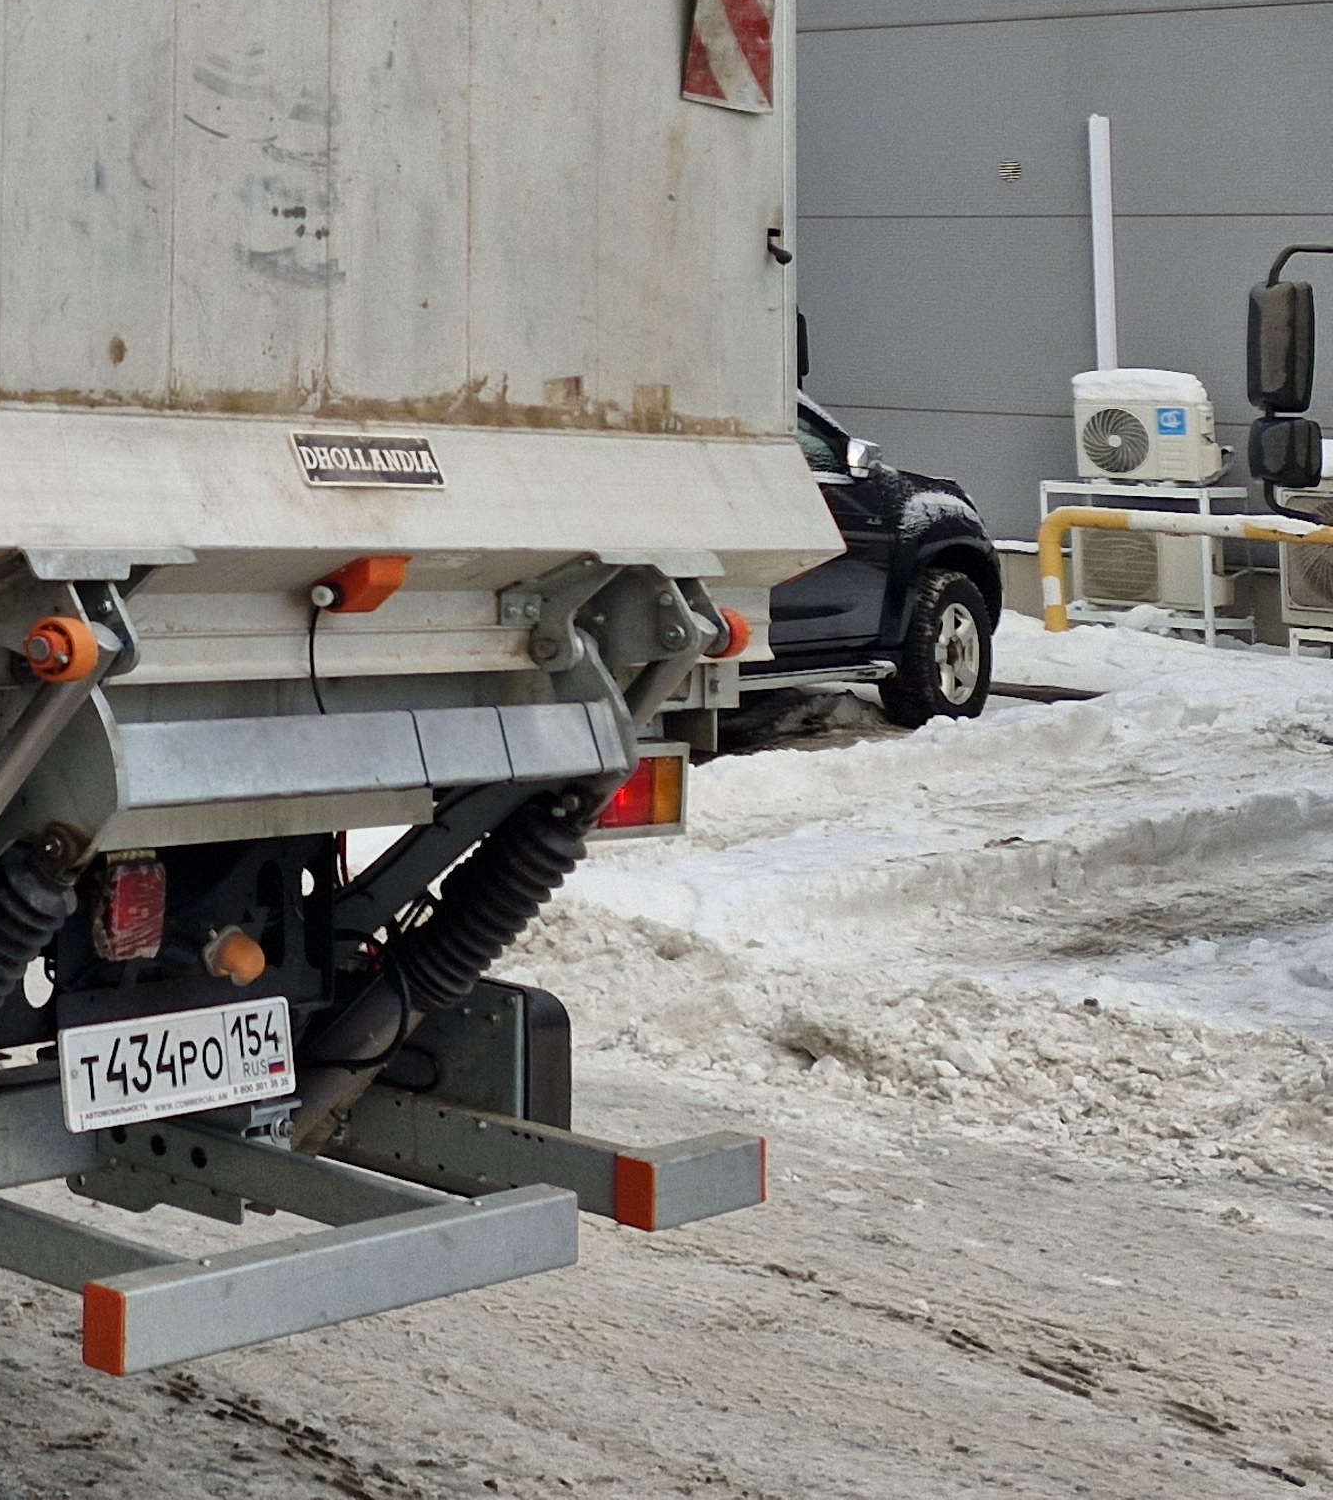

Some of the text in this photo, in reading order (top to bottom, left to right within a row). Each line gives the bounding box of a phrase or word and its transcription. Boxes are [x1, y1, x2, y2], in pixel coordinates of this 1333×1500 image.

[299, 446, 438, 473] DHOLLANDIA
[231, 1010, 279, 1059] 154
[243, 1059, 268, 1077] RUS
